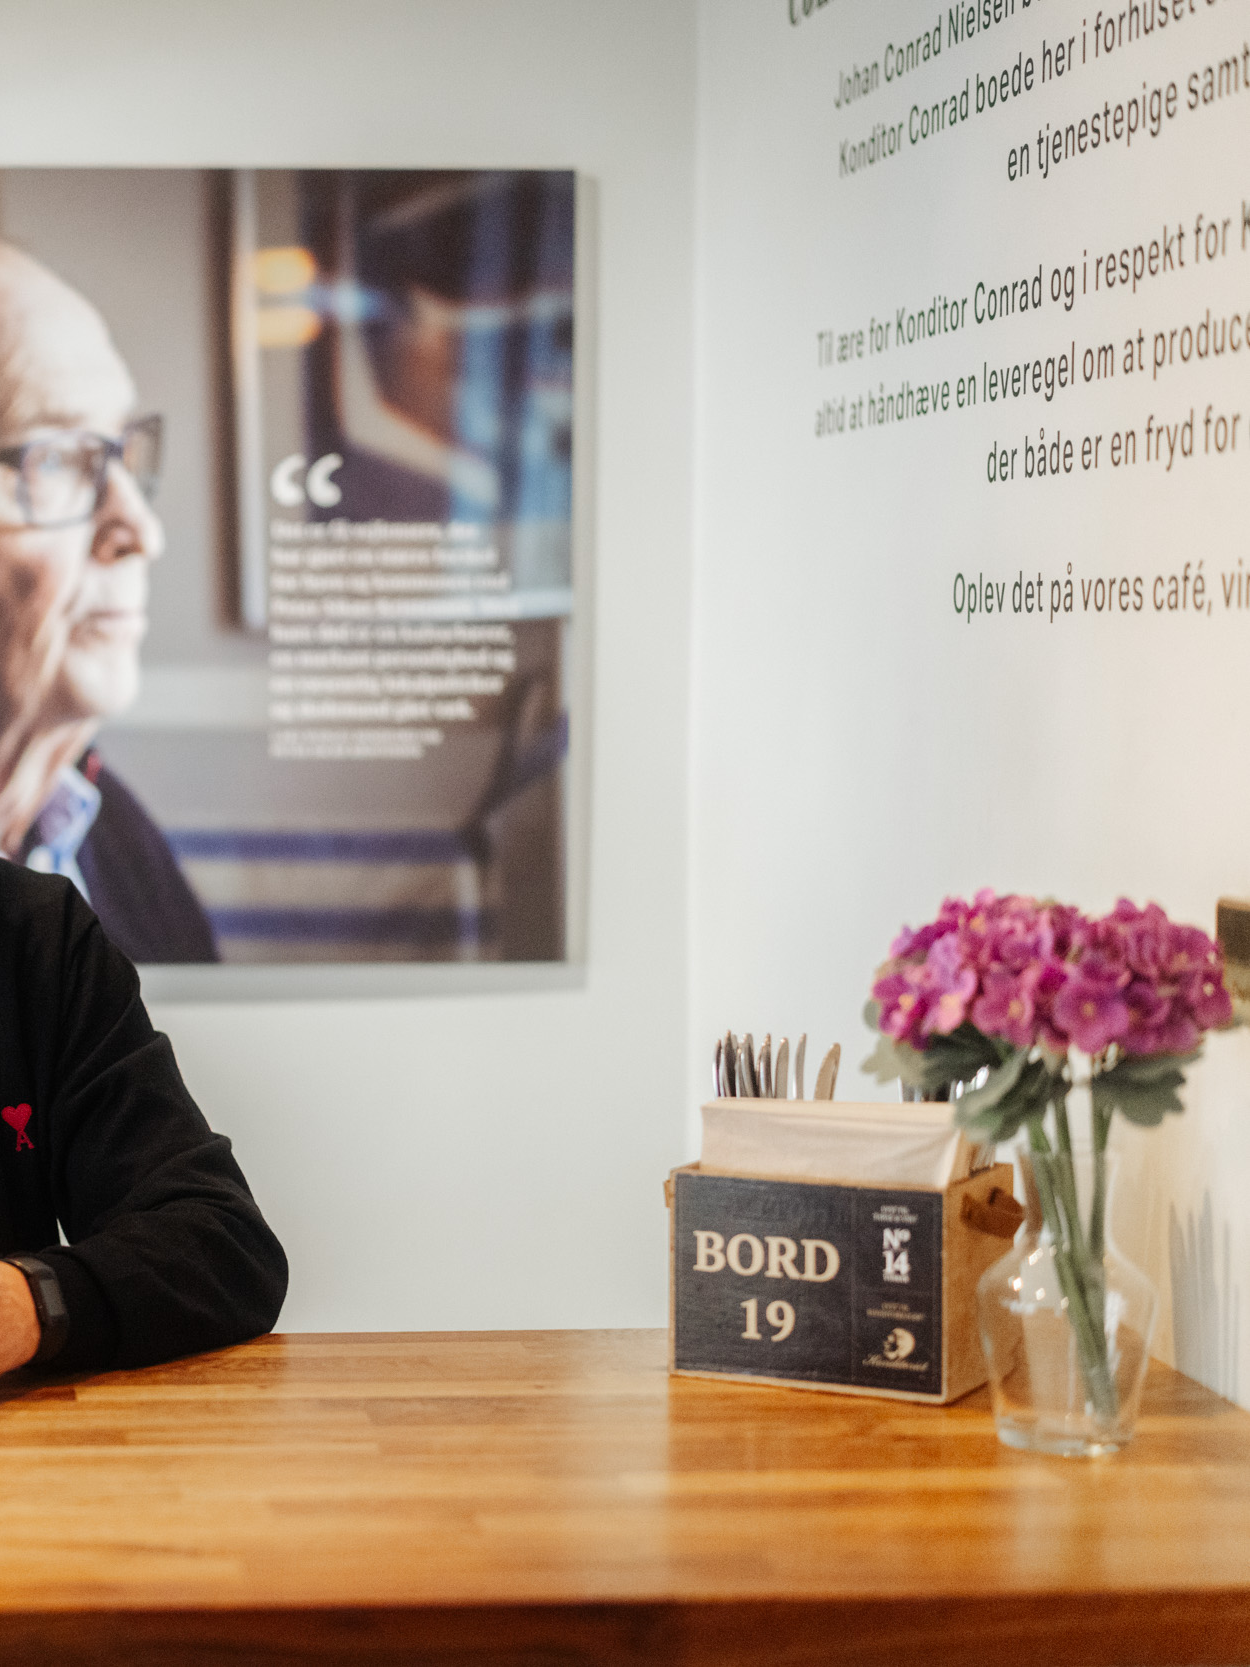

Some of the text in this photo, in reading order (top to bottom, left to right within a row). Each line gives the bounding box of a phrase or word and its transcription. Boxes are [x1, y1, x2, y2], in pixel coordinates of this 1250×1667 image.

[834, 61, 879, 109] Johan
[884, 14, 942, 82] Conrad
[839, 122, 903, 178] Konditor
[909, 78, 969, 145] Conrad
[976, 52, 1034, 114] boede
[1042, 40, 1075, 83] her
[1081, 18, 1087, 65] i
[1007, 42, 1250, 181] en tjenestepige samt
[817, 328, 833, 368] Til
[836, 329, 864, 363] ære
[869, 316, 891, 355] for
[896, 294, 967, 347] Konditor
[974, 264, 1042, 324] Conrad
[1051, 266, 1075, 312] og
[1082, 249, 1087, 295] i
[1095, 224, 1185, 294] respekt
[1194, 213, 1231, 263] for
[815, 395, 845, 438] altid
[849, 395, 863, 430] at
[868, 380, 950, 426] håndhæve
[956, 374, 976, 409] en
[983, 341, 1075, 402] leveregel
[1083, 343, 1114, 382] om
[1123, 328, 1144, 374] at
[987, 404, 1240, 483] der både er en fryd for
[953, 572, 1005, 624] Oplev
[1012, 570, 1043, 613] det
[1049, 561, 1073, 624] på
[1081, 576, 1144, 612] vores
[1153, 560, 1212, 616] café,
[693, 1230, 840, 1283] BORD
[882, 1250, 911, 1275] 14
[740, 1298, 796, 1342] 19
